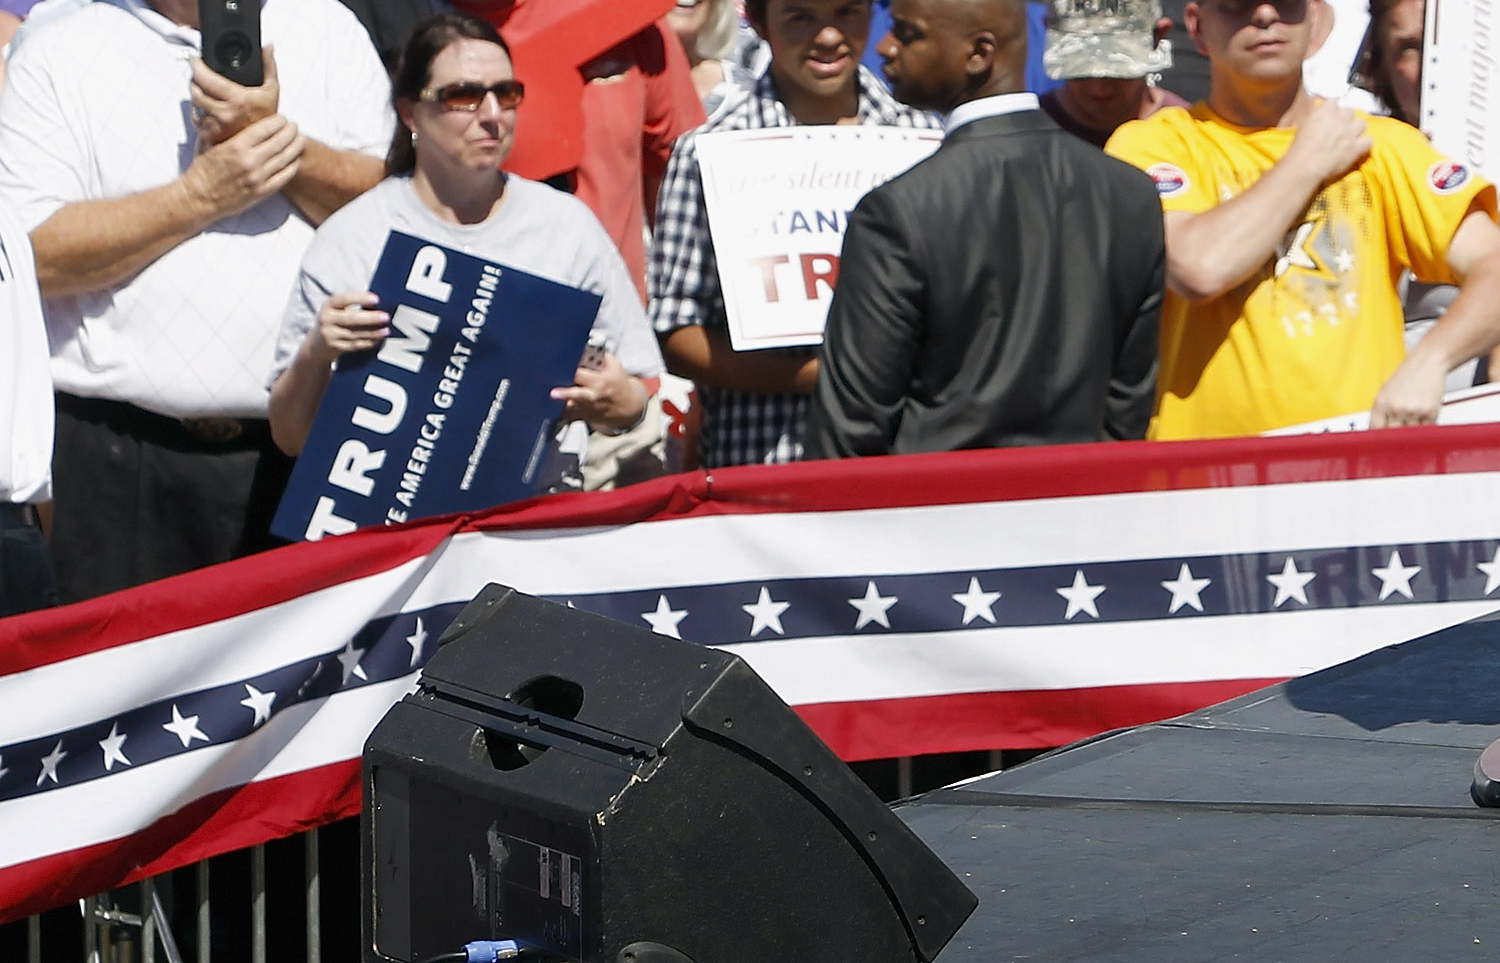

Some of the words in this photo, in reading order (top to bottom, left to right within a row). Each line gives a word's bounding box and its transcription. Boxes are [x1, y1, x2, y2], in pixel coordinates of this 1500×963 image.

[788, 159, 862, 189] silent
[460, 264, 503, 344] AGAIN!
[304, 244, 454, 542] TRUMP
[432, 341, 474, 410] GREAT
[394, 412, 448, 514] AMERICA
[384, 505, 409, 529] E
